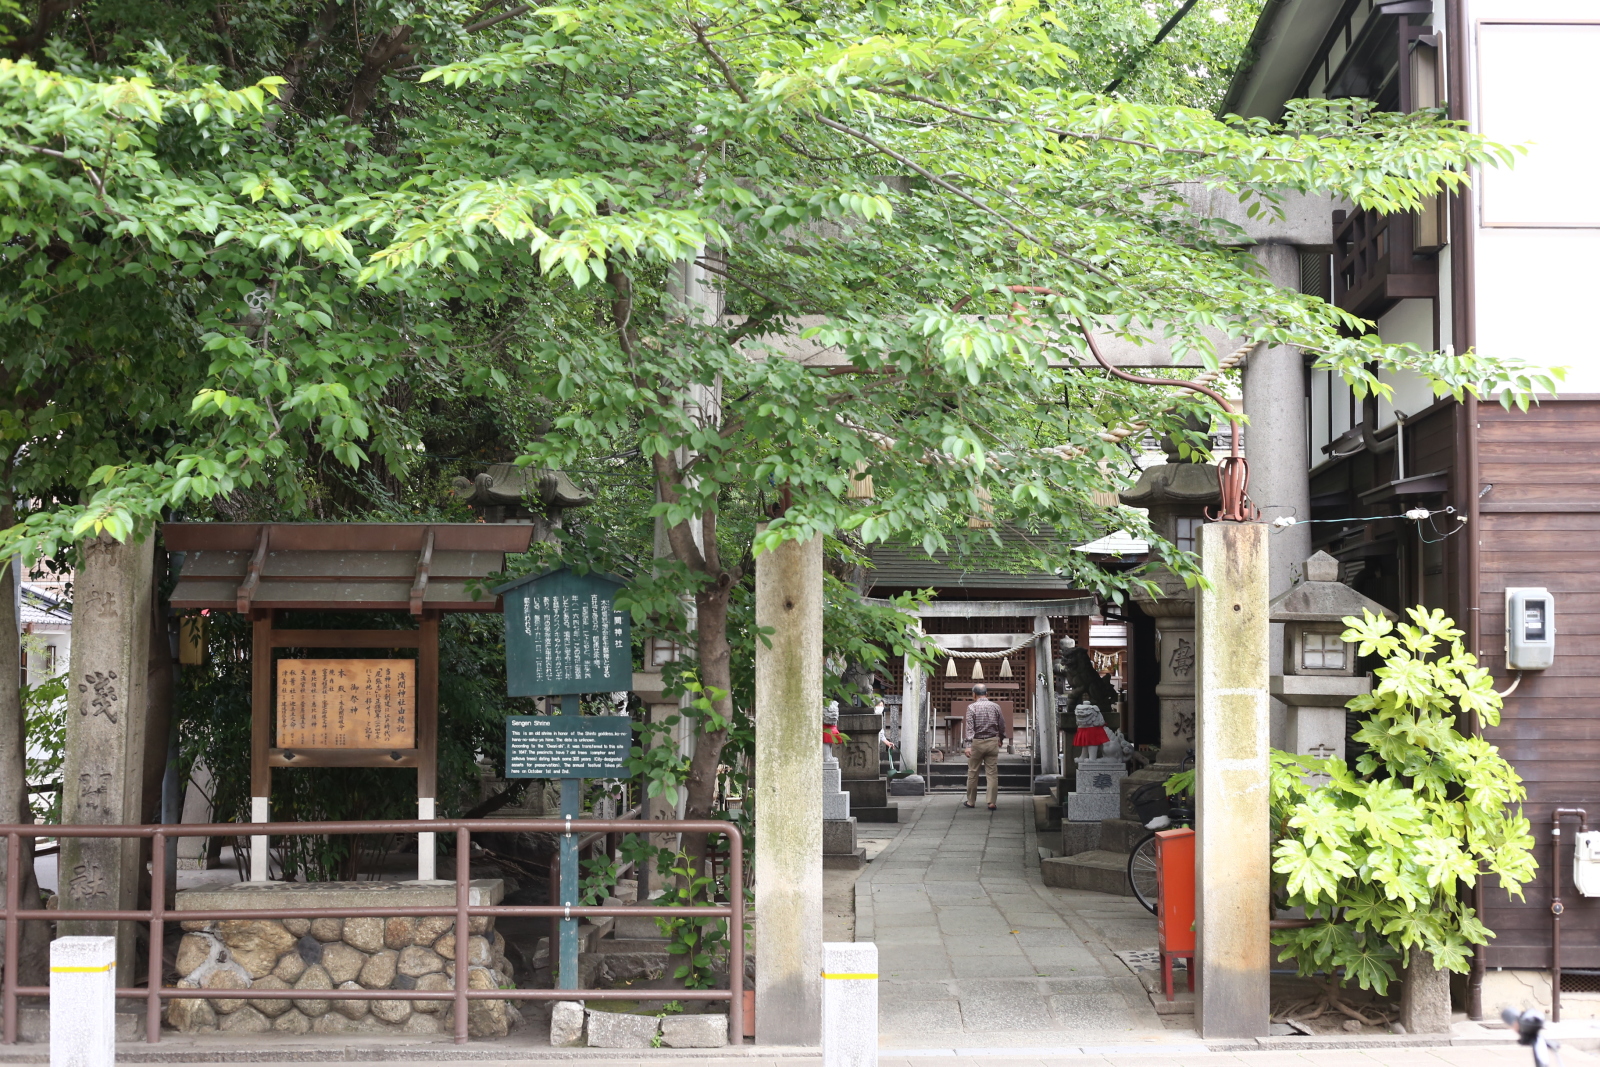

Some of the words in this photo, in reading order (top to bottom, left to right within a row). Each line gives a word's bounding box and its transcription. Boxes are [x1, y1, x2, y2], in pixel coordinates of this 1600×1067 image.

[349, 683, 359, 716] 御祭神
[1093, 773, 1112, 790] 奉
